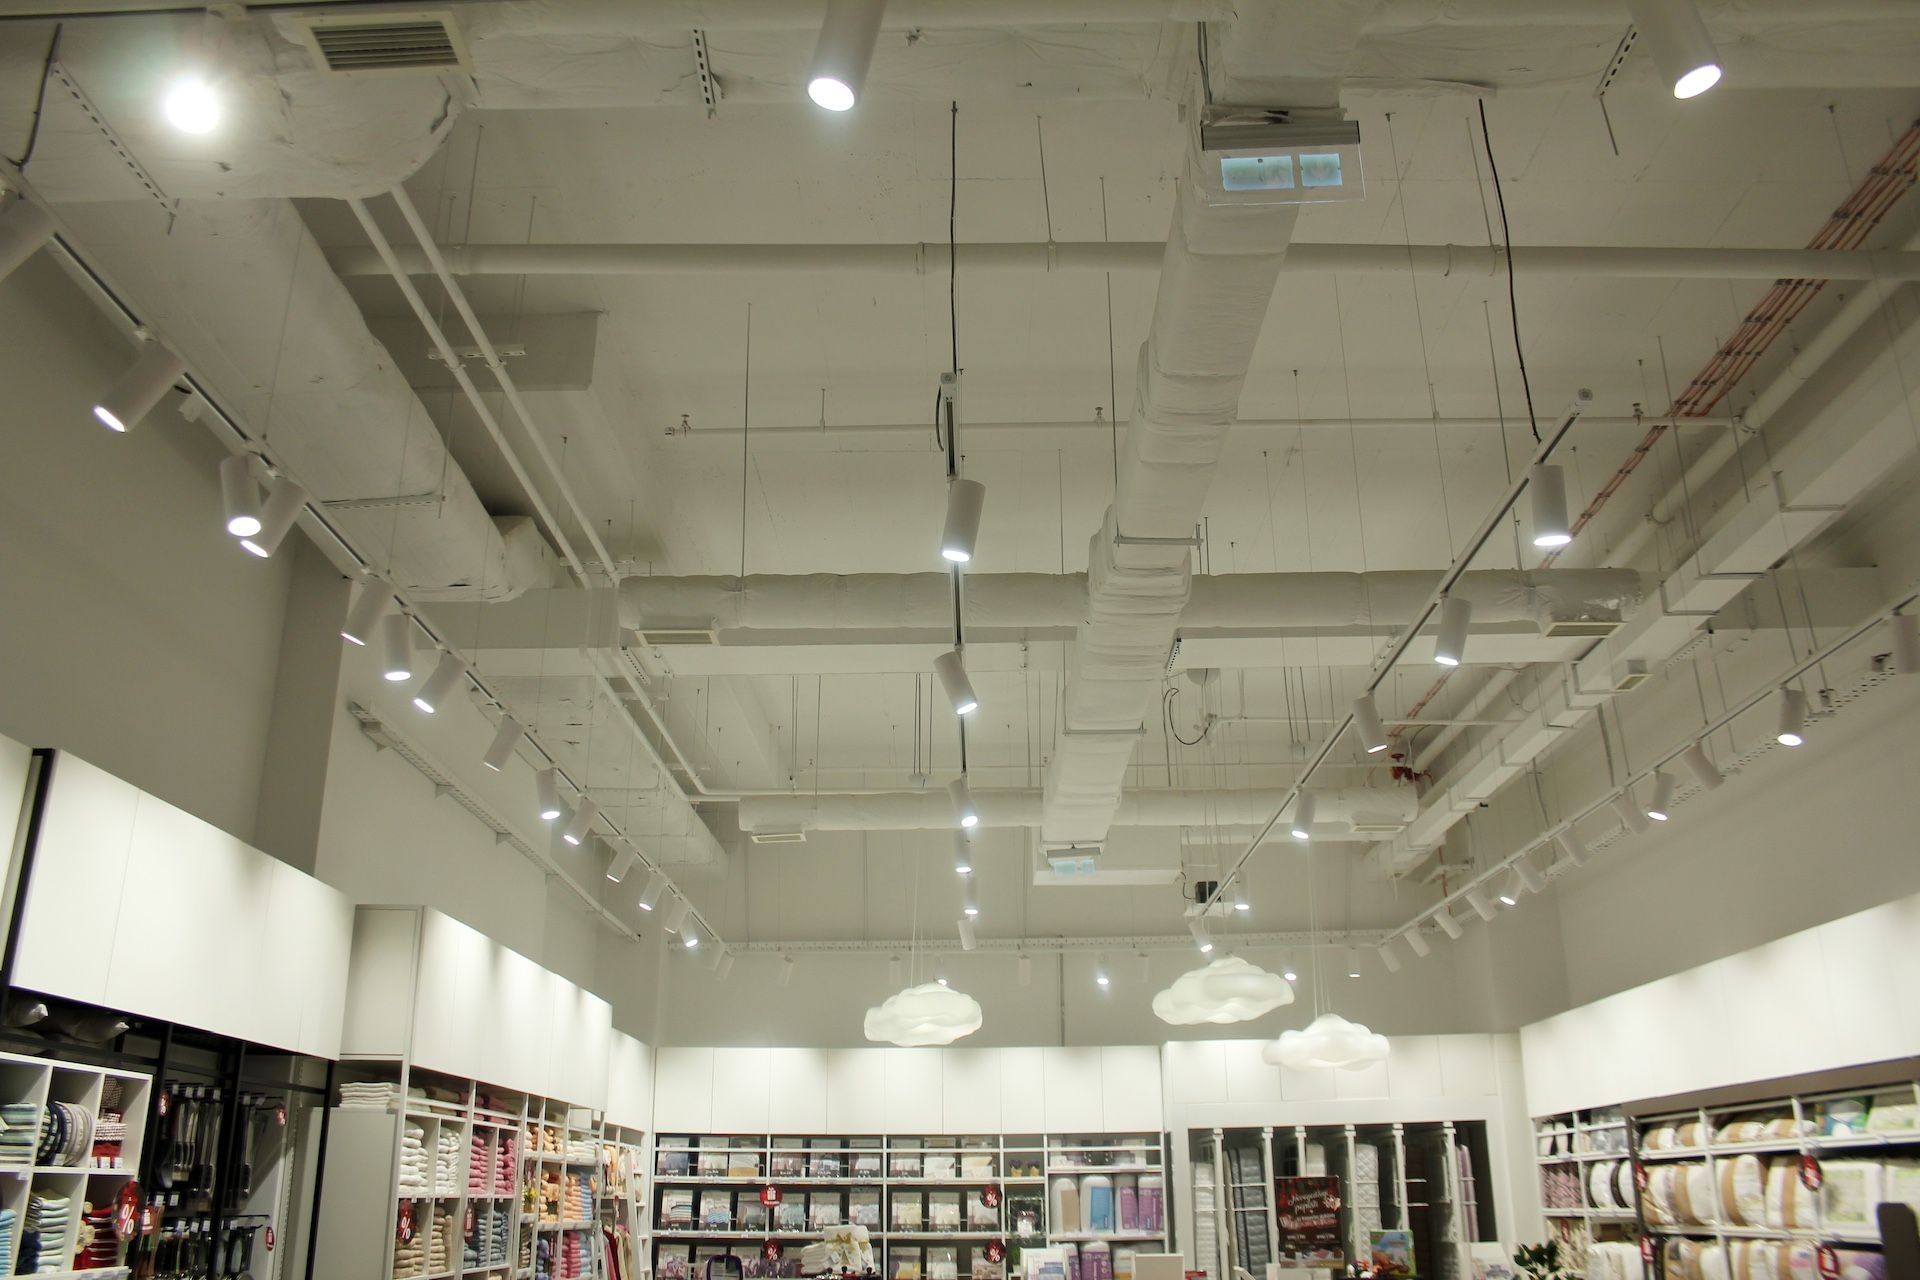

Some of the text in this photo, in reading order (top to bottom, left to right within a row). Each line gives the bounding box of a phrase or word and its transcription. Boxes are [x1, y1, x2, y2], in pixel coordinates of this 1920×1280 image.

[987, 1193, 997, 1207] %
[121, 1205, 135, 1234] %
[401, 1216, 411, 1239] %
[989, 1248, 1000, 1262] %
